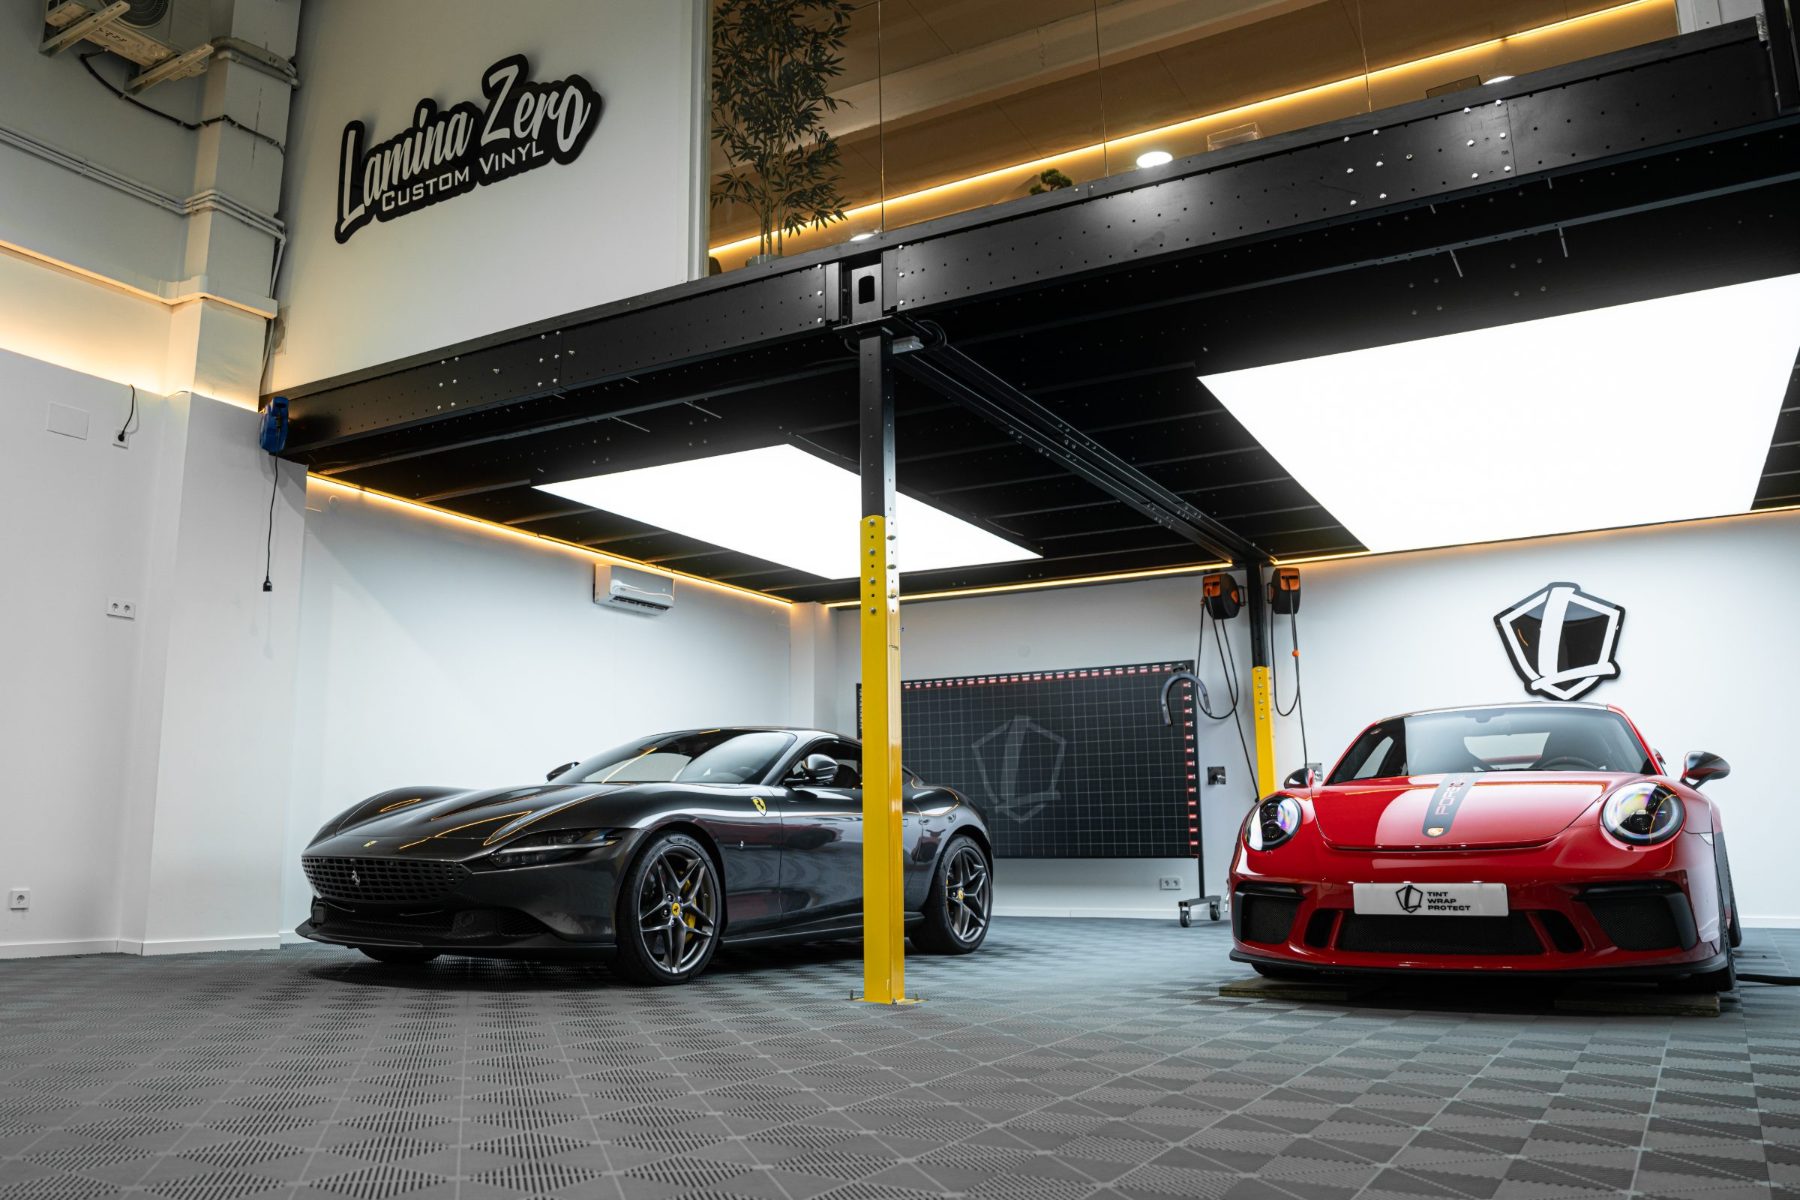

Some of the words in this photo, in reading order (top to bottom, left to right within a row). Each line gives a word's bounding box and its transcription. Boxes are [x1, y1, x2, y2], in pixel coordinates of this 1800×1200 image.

[341, 108, 474, 233] Lamina
[481, 64, 591, 152] Zero
[382, 167, 469, 211] CUSTOM
[479, 141, 543, 174] VINYL
